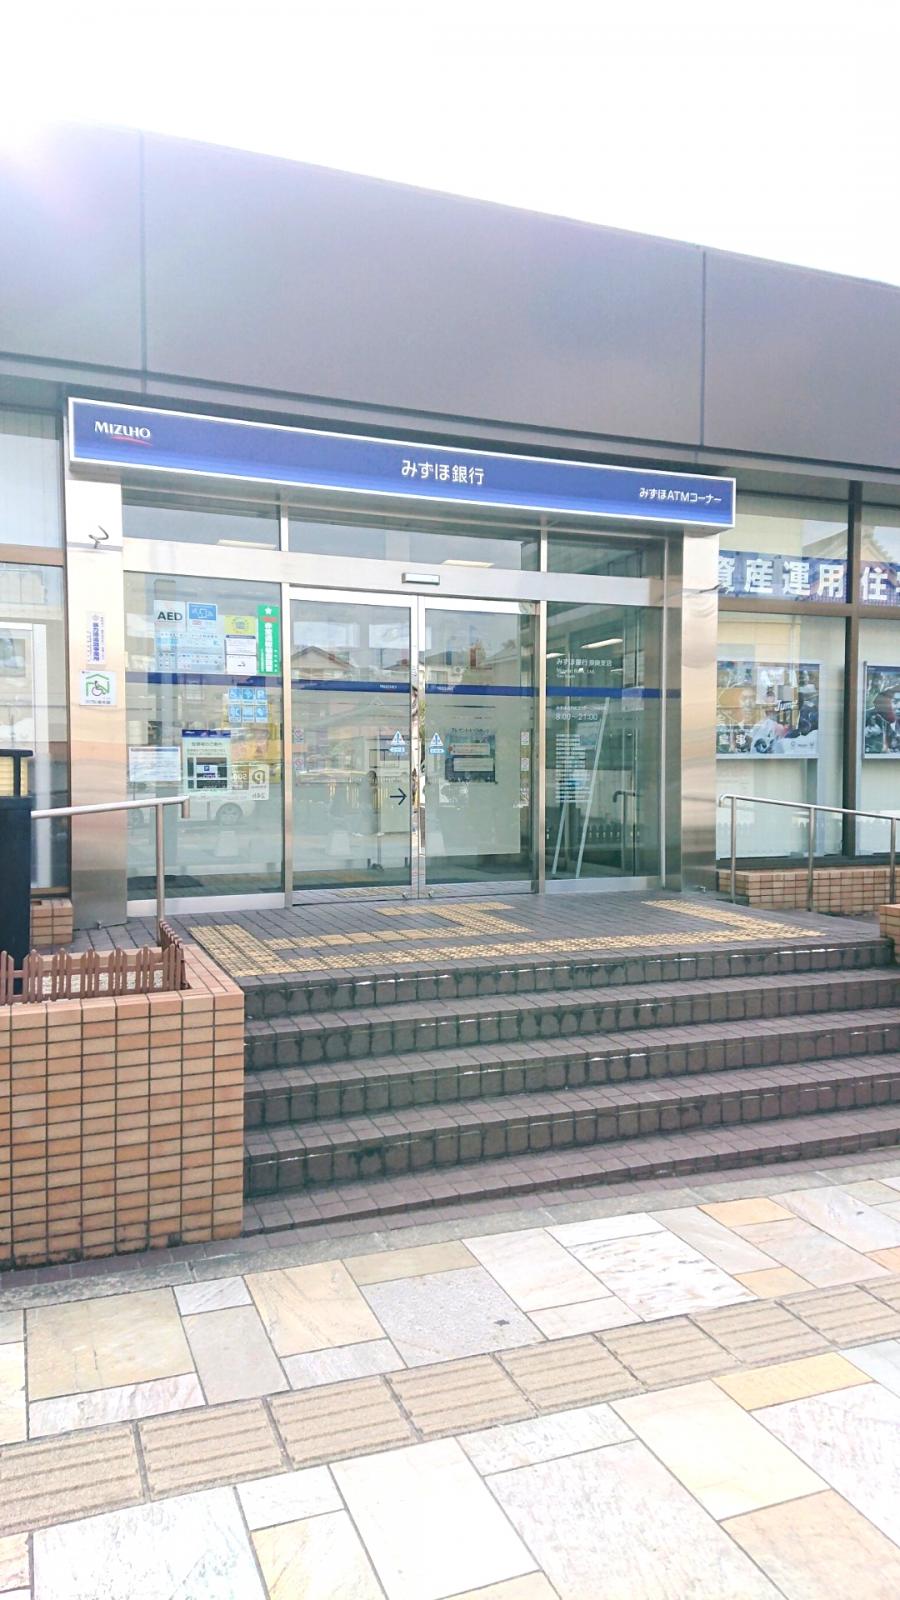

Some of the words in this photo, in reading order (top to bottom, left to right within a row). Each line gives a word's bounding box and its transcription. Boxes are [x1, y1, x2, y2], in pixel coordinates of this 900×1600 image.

[94, 421, 151, 438] MIZUHO
[401, 460, 484, 485] みずほ銀行
[639, 487, 722, 503] みずほATMコーナー
[861, 566, 900, 600] 住
[157, 611, 183, 621] AED
